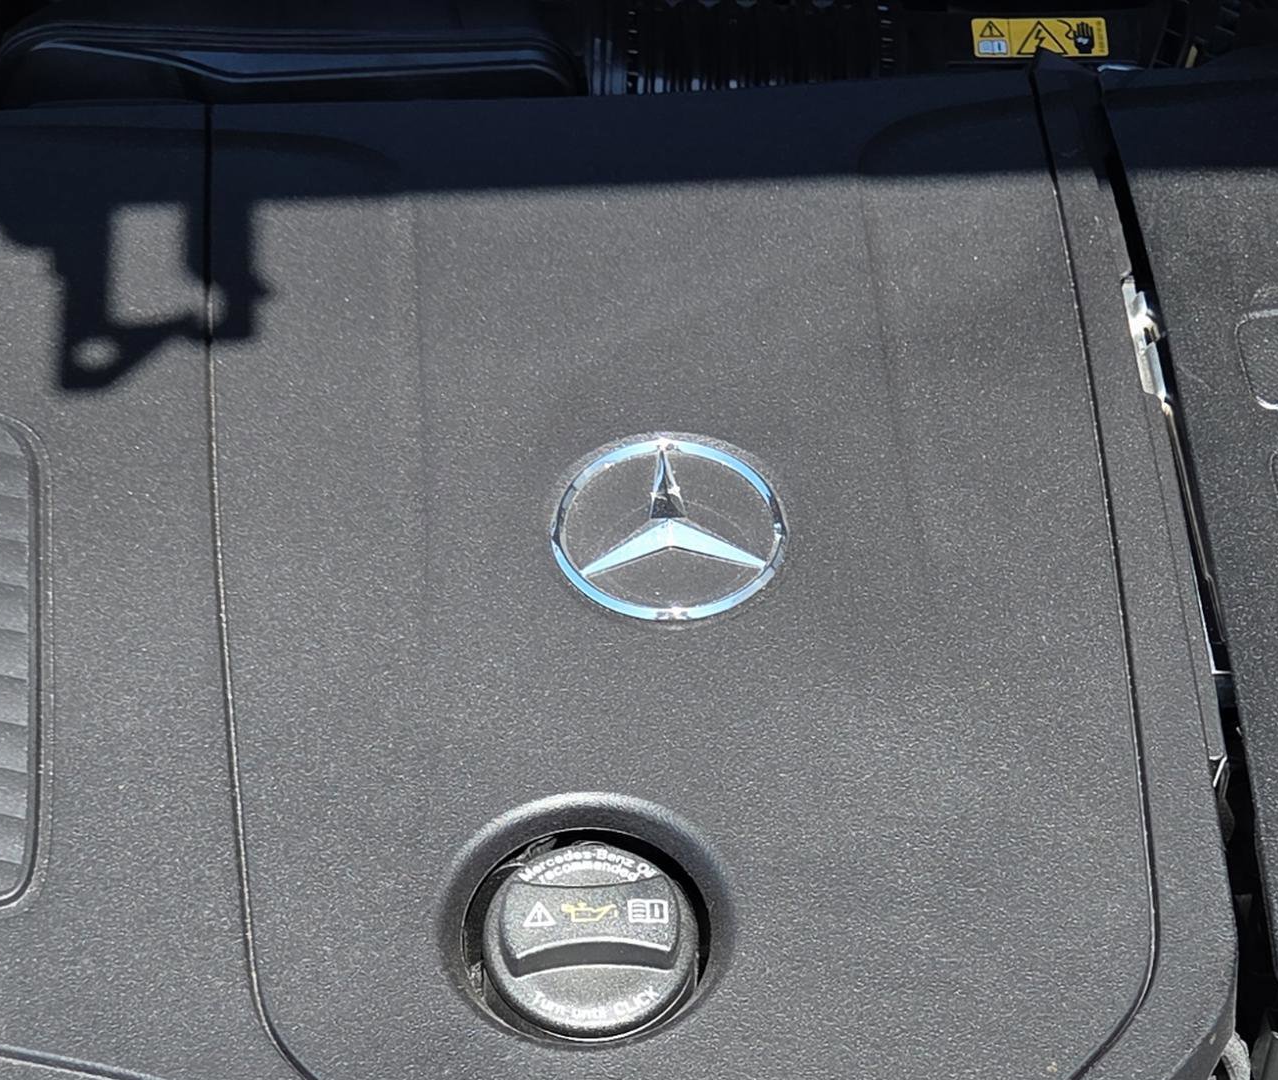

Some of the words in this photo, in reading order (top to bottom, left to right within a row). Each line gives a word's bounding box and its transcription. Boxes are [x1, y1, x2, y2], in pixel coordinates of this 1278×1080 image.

[518, 848, 635, 882] Mercedes-Benz
[537, 859, 640, 883] recommended
[533, 990, 567, 1016] Turn
[613, 986, 661, 1017] CLICK
